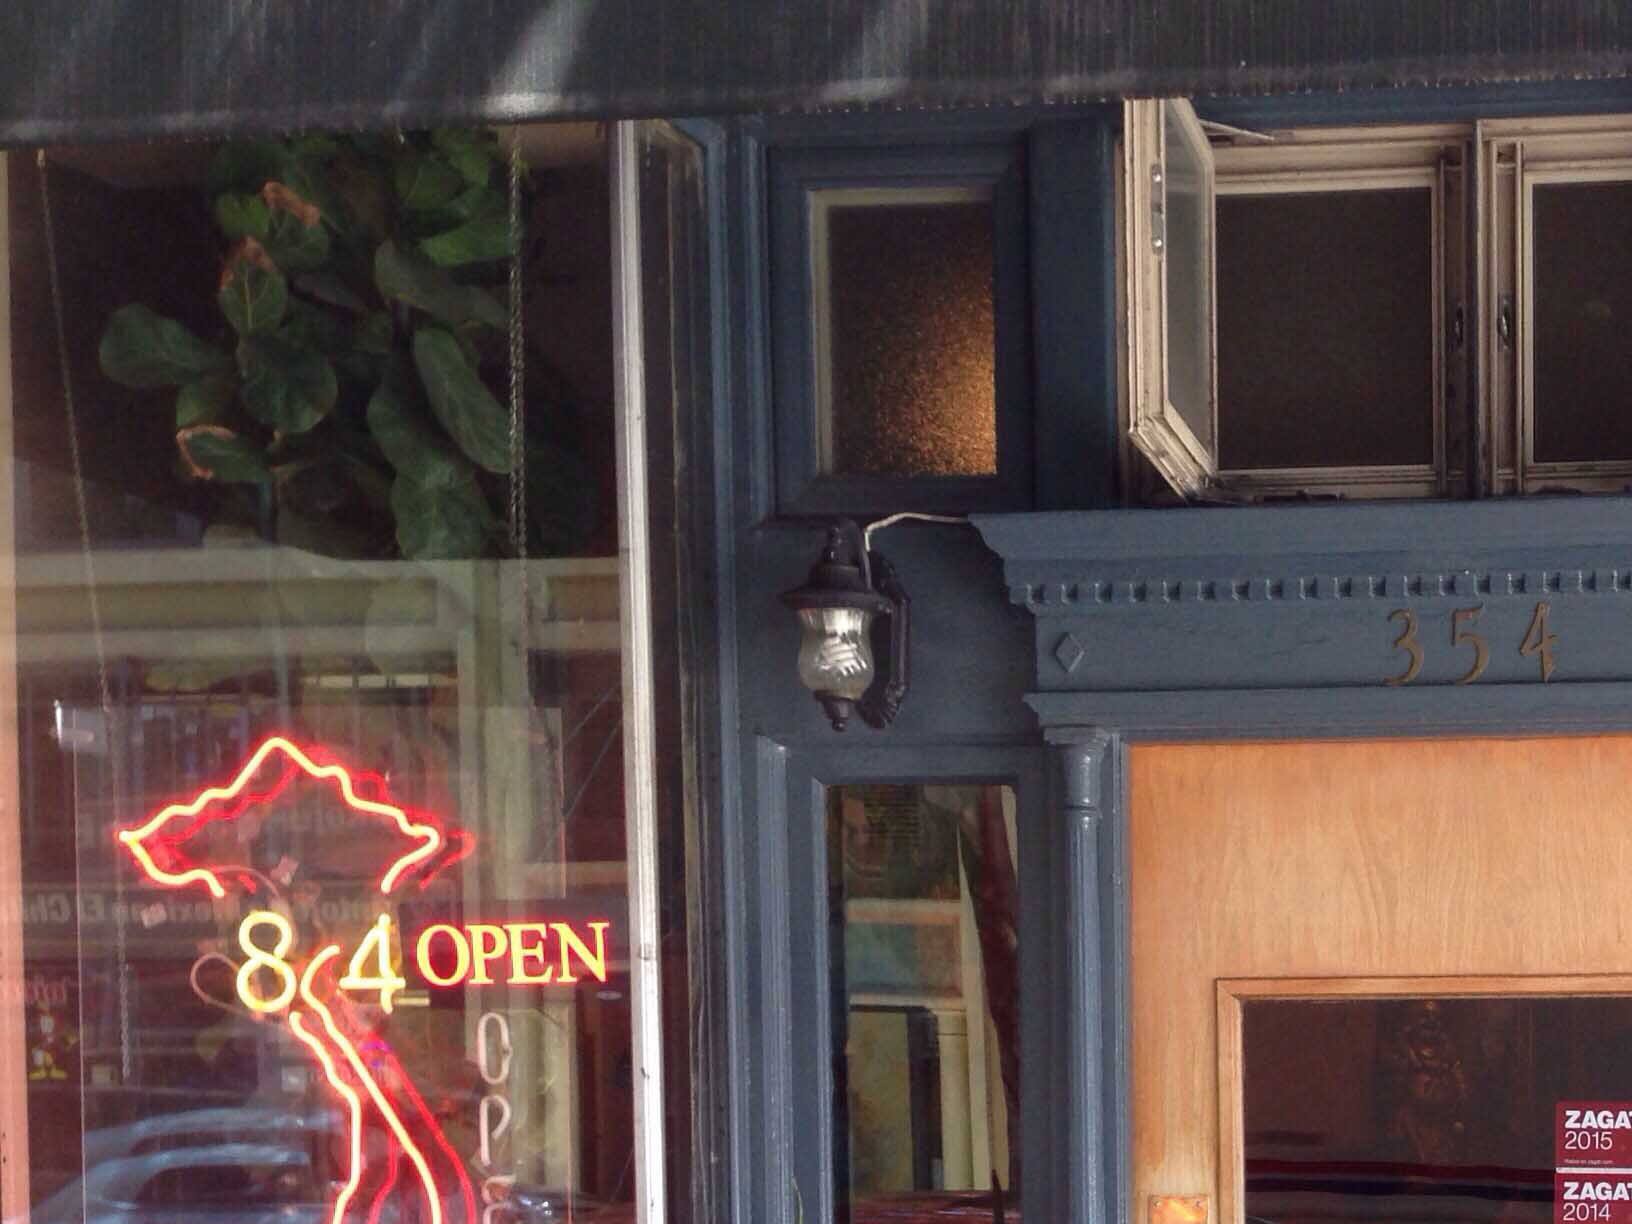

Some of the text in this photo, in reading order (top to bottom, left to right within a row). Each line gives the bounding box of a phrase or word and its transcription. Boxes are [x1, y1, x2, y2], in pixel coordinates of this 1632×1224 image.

[1384, 601, 1557, 686] 354
[416, 922, 609, 987] OPEN
[1564, 1131, 1613, 1151] 2015
[1563, 1203, 1611, 1222] 2014
